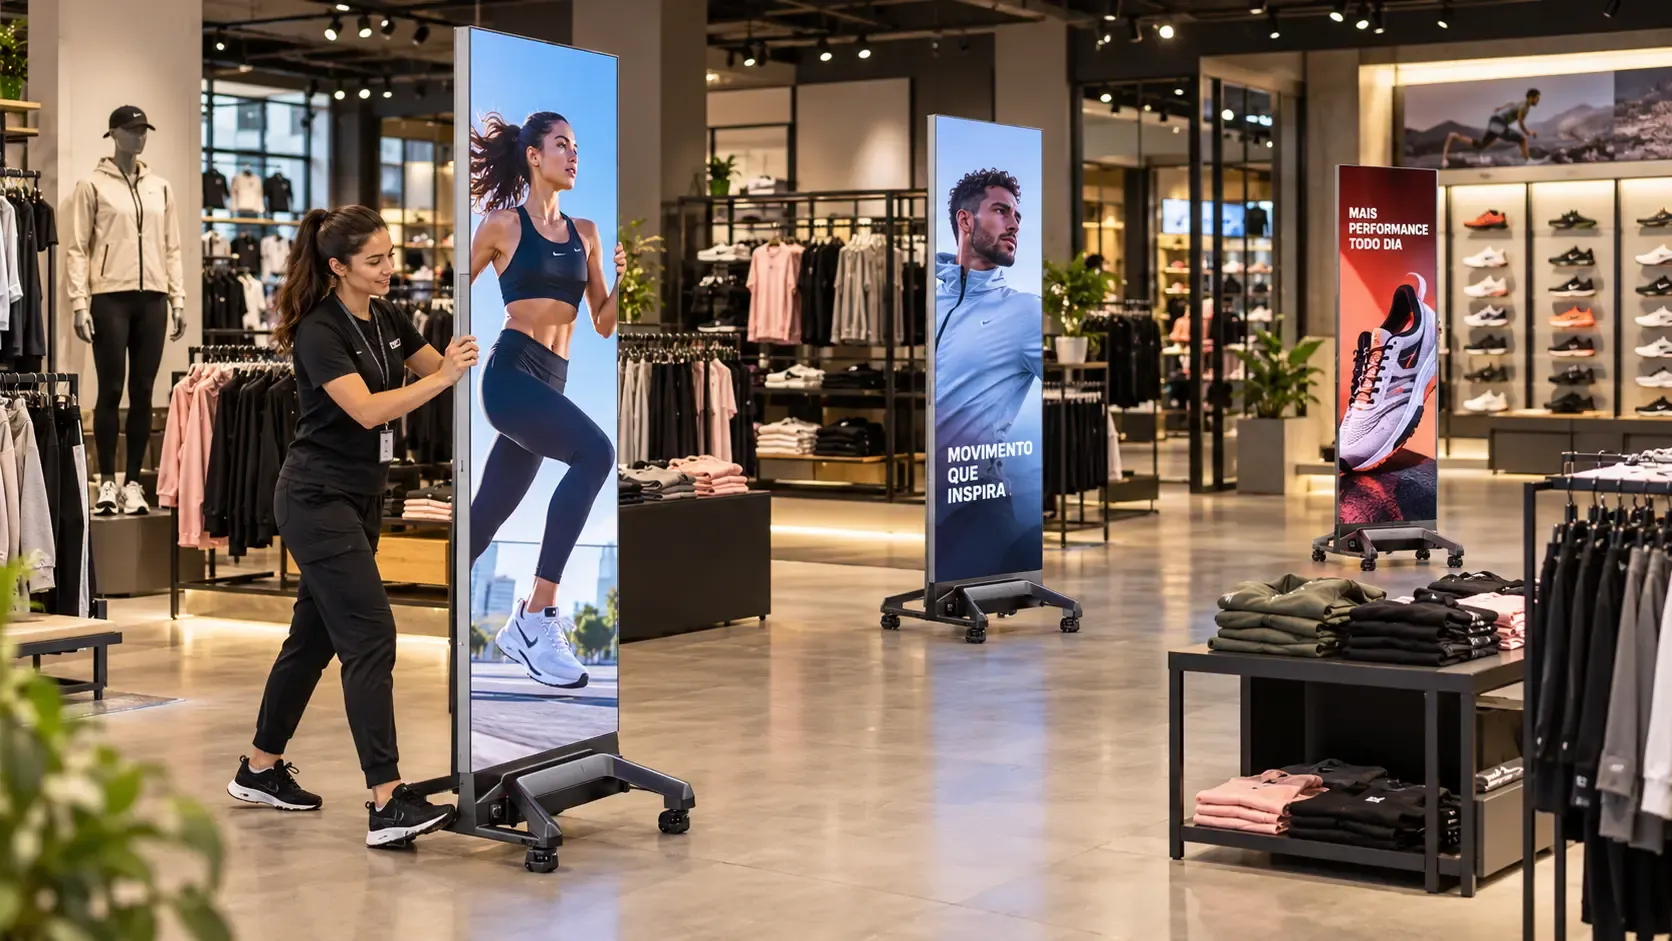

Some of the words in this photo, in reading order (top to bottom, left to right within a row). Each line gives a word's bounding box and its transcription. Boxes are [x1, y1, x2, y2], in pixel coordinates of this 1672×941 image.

[1349, 207, 1377, 219] MAIS
[1349, 222, 1429, 235] PERFORMANCE
[1349, 237, 1380, 250] TODO
[1383, 238, 1403, 250] DIA
[948, 440, 1033, 463] MOVIMENTO
[948, 465, 978, 484] QUE
